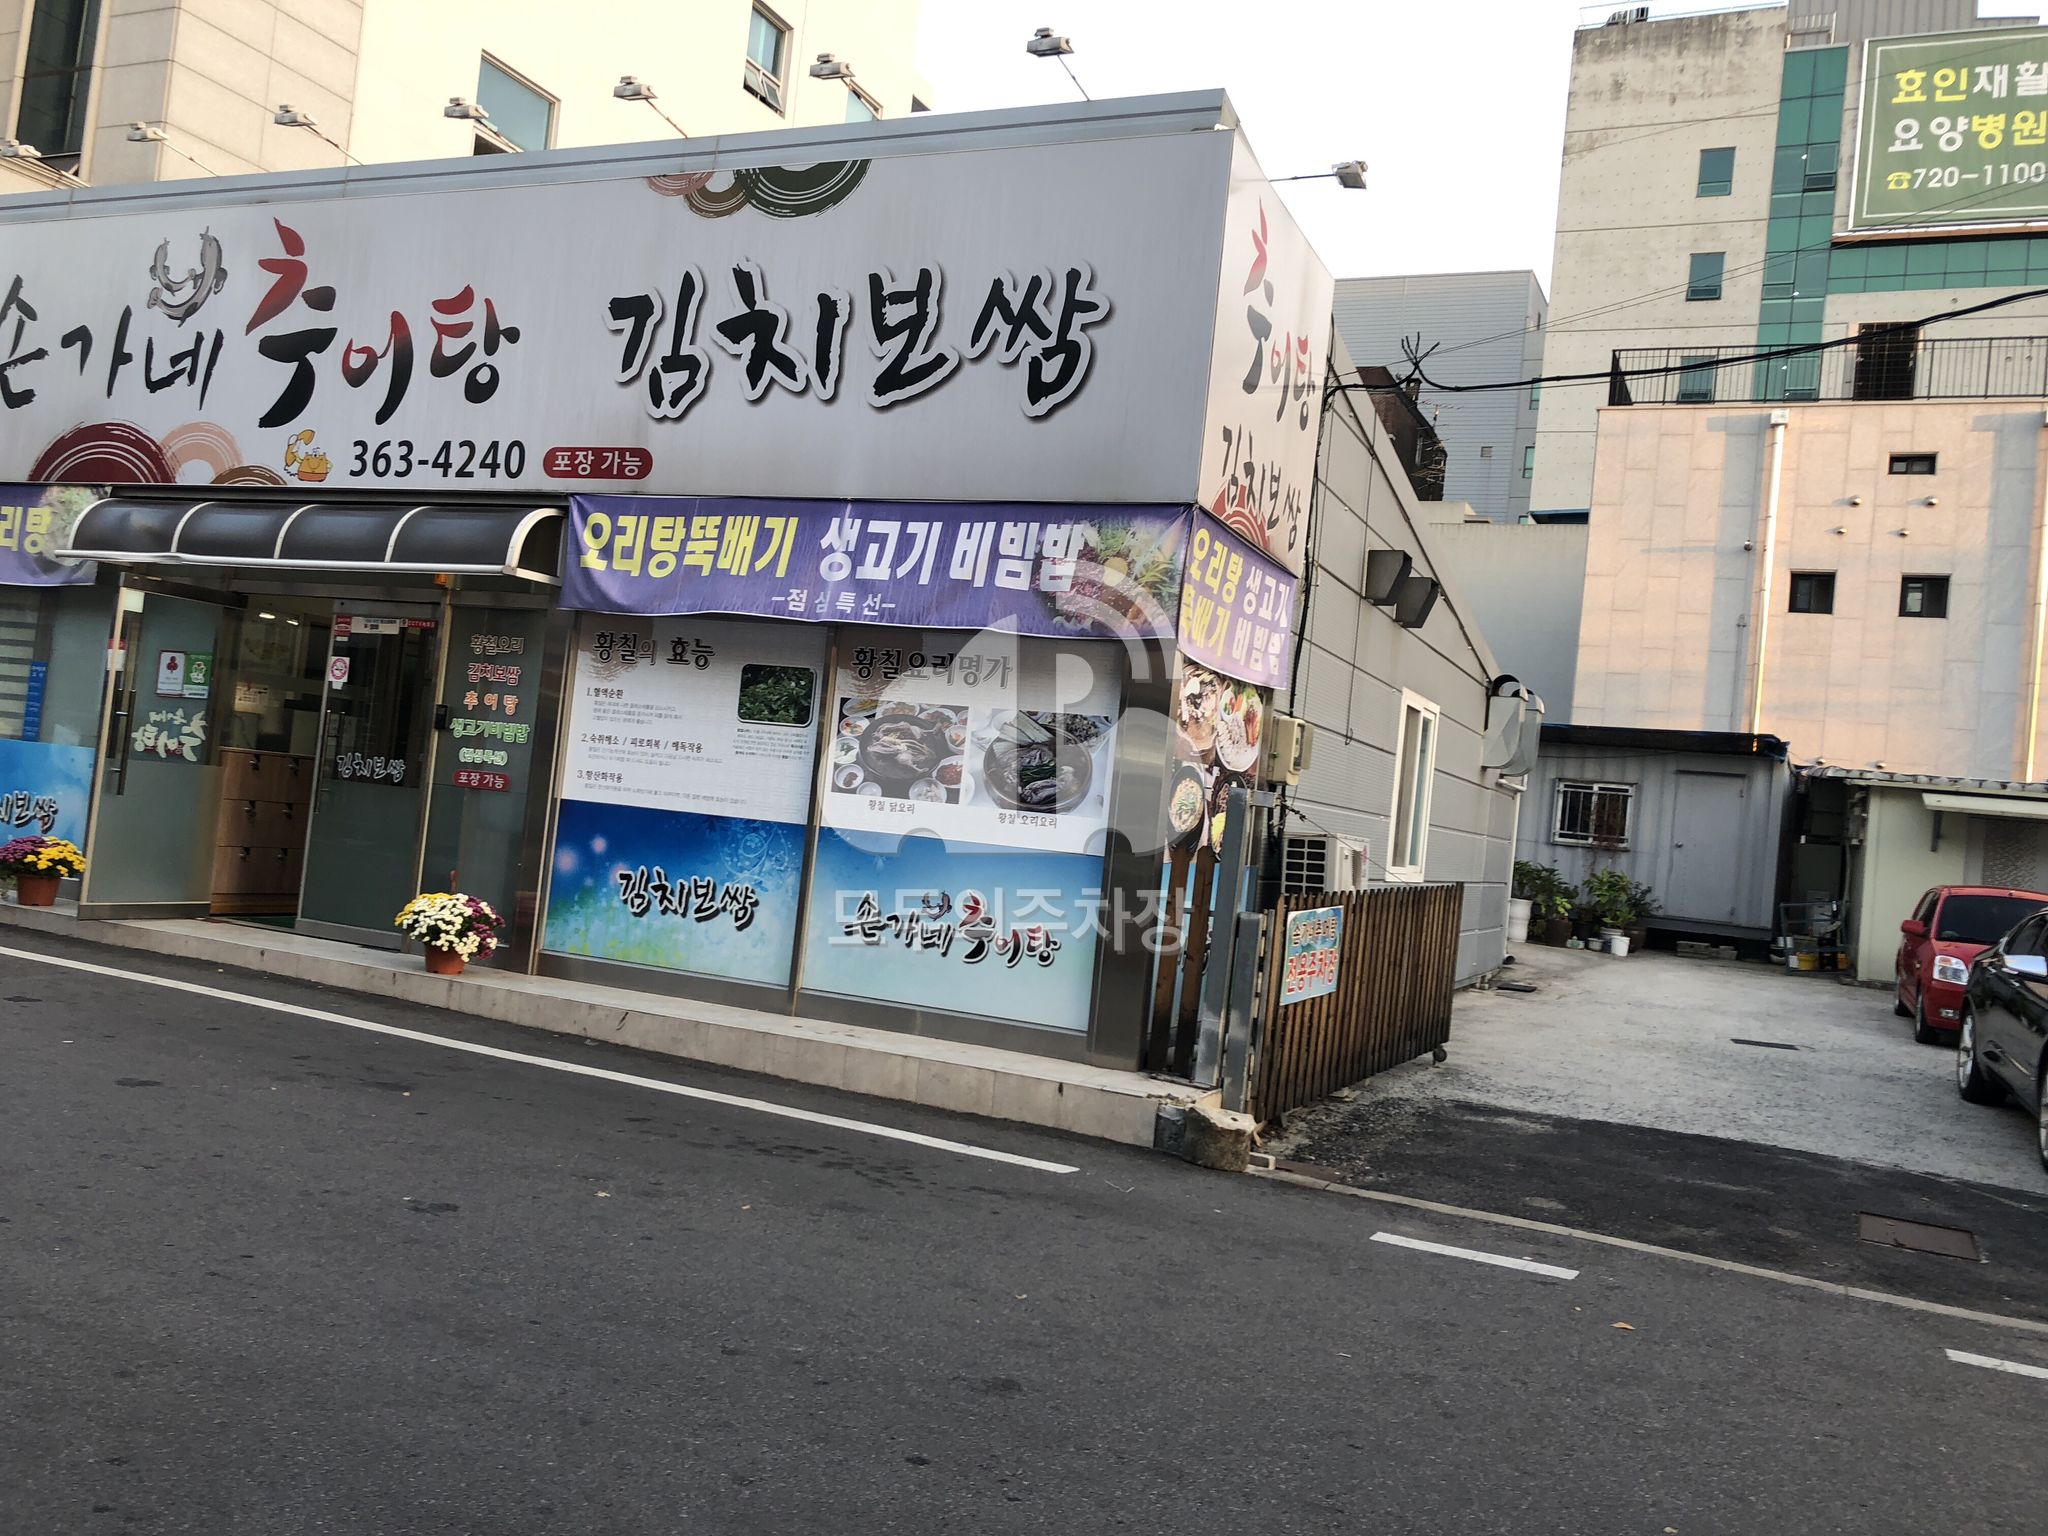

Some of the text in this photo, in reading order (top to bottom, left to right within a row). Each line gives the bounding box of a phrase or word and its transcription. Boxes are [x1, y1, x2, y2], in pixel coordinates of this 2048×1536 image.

[1891, 61, 2048, 104] 효인재활
[1887, 110, 2047, 153] 요양병원
[1913, 161, 2046, 189] 720-1100
[245, 216, 521, 430] 추어탕
[1242, 196, 1315, 432] 추어탕
[604, 261, 1107, 416] 김치보쌈
[349, 439, 527, 480] 363-4240
[552, 450, 645, 478] 포장 가능
[1223, 423, 1304, 553] 김치보쌈
[580, 512, 1086, 592] 오리탕뚝배기 생고기 비빔밥
[1189, 528, 1290, 628] 오리탕 생고기
[594, 631, 716, 671] 황칠의 효능
[1232, 617, 1285, 675] 비빔밥
[467, 663, 522, 686] 김치보쌈
[852, 647, 1013, 690] 황칠요리명가
[450, 718, 530, 744] 생고기비빔밥
[336, 752, 407, 783] 김치보쌈
[457, 771, 505, 789] 포장 가능
[868, 798, 887, 812] 황칠
[1019, 814, 1058, 829] 오리요리
[616, 866, 759, 930] 김치보쌈
[843, 888, 1061, 968] 손가네 추어탕
[1285, 948, 1339, 995] 전용주차장
